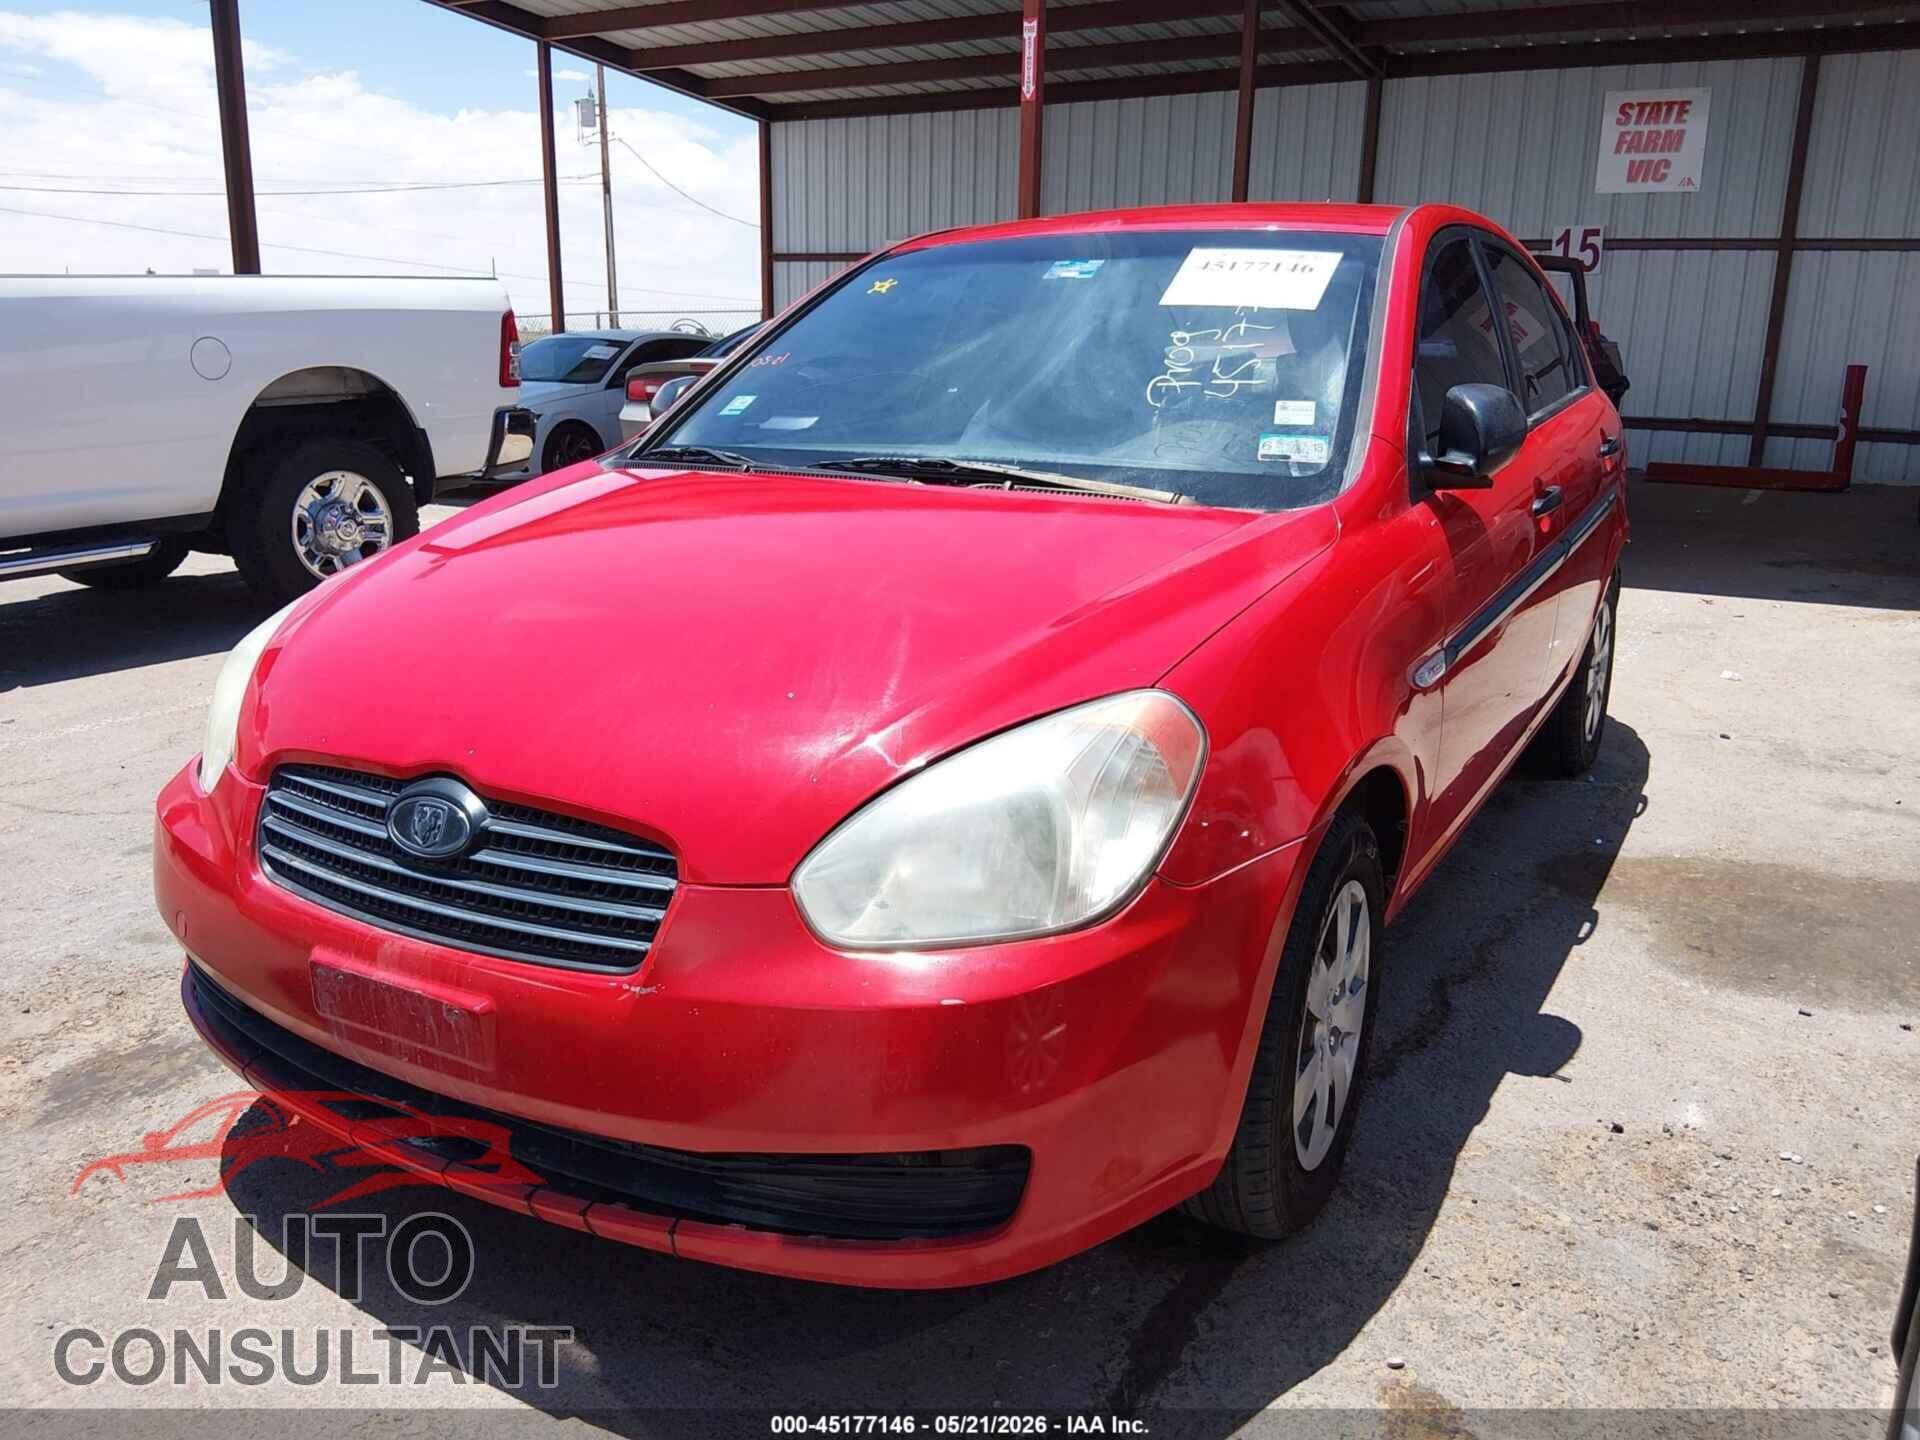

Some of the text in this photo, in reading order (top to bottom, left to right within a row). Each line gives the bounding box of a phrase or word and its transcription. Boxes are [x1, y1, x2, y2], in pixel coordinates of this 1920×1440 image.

[1615, 100, 1692, 126] STATE
[1613, 129, 1687, 155] FARM
[1626, 158, 1672, 183] VIC
[1555, 228, 1601, 273] 15
